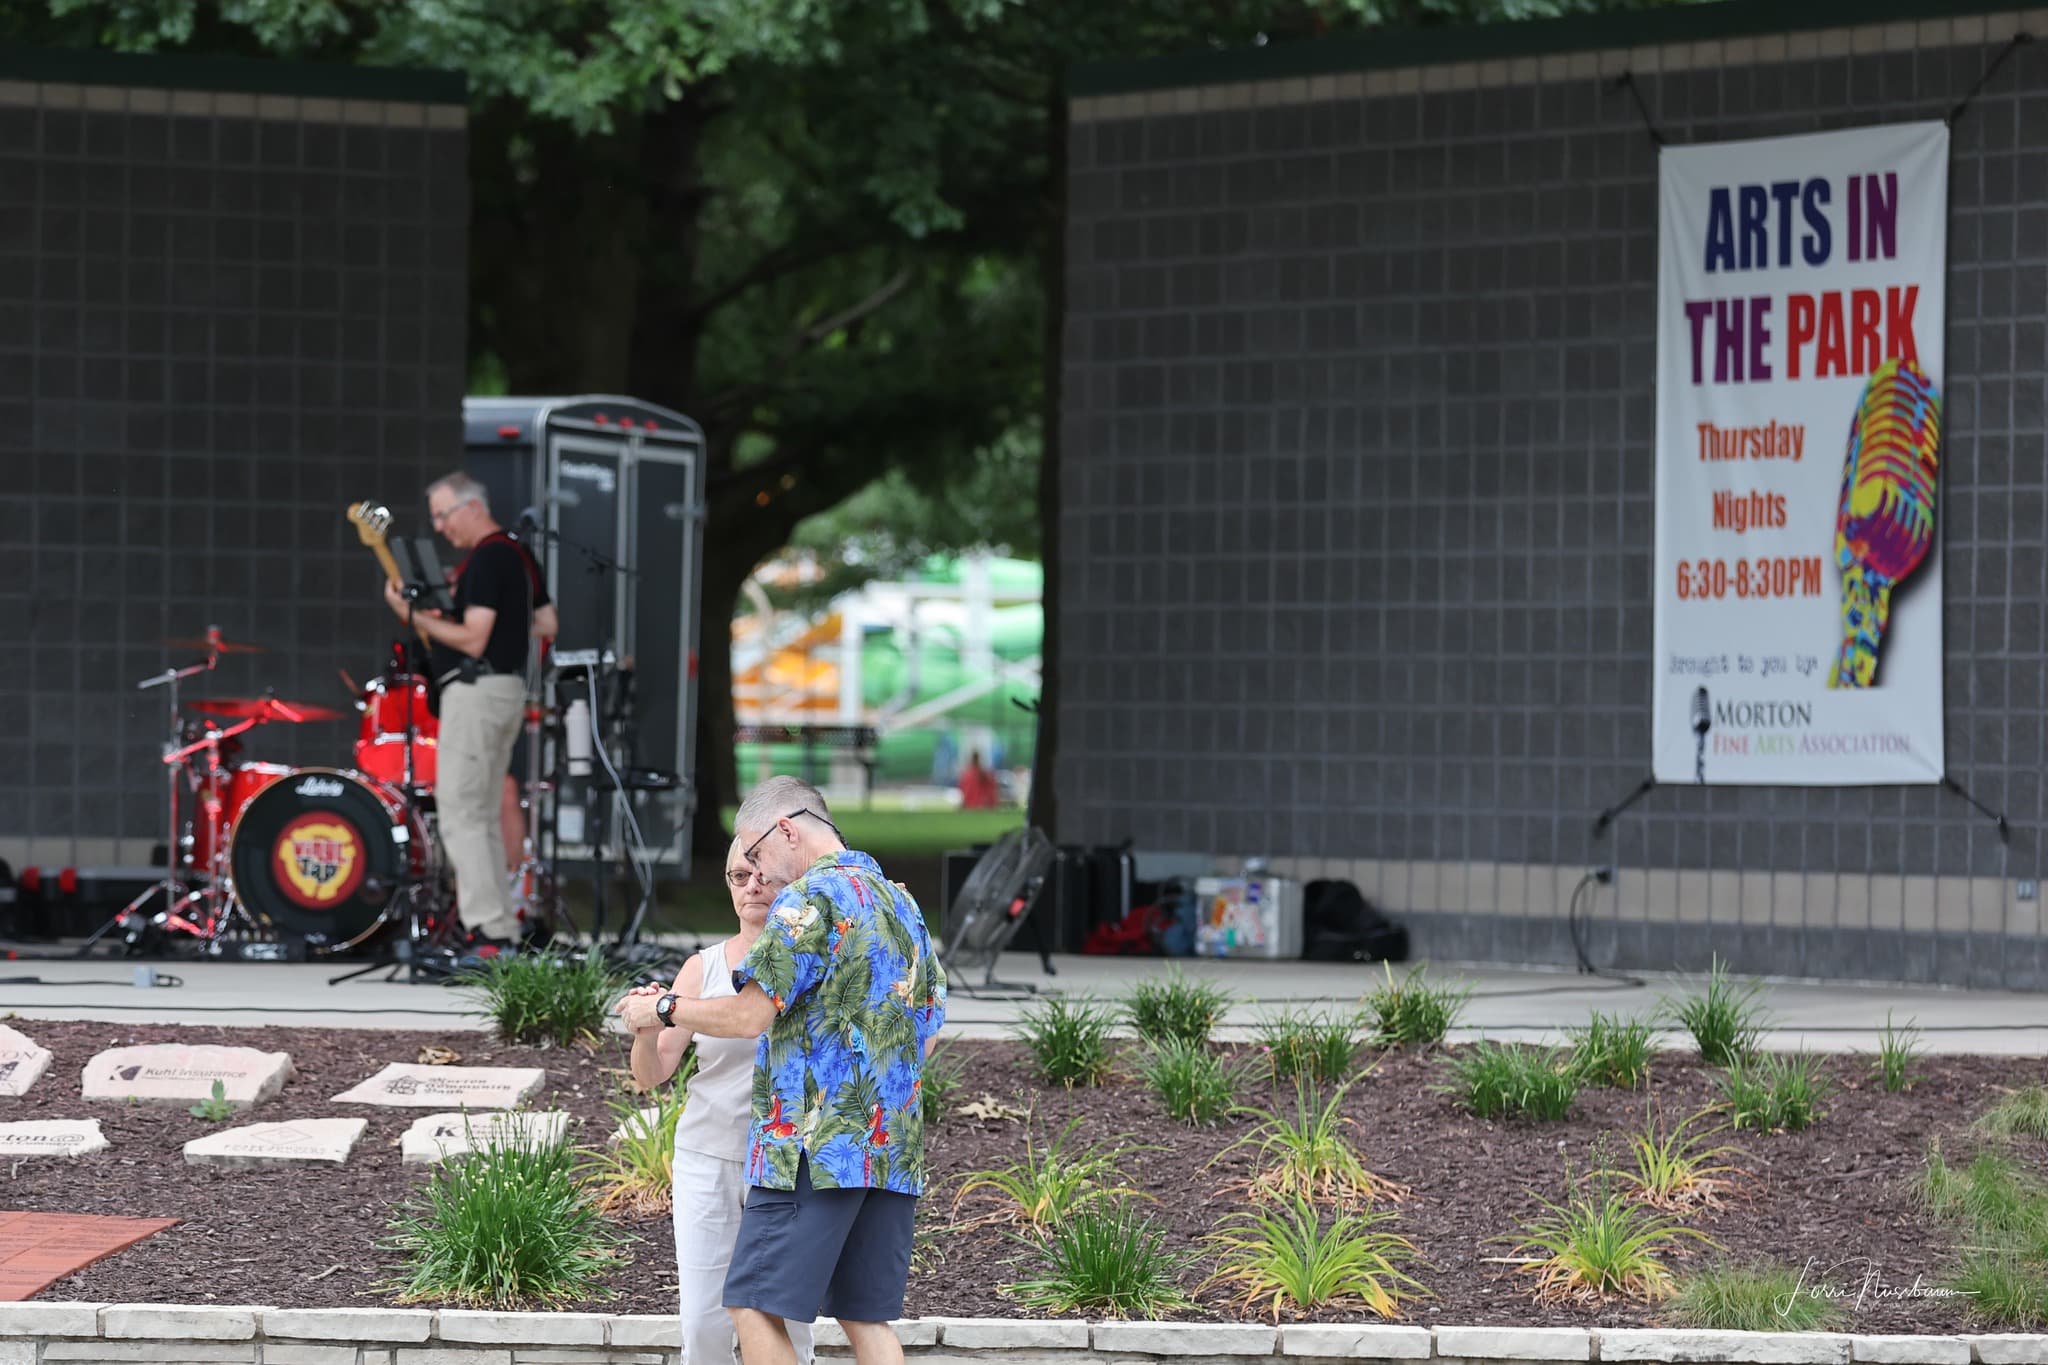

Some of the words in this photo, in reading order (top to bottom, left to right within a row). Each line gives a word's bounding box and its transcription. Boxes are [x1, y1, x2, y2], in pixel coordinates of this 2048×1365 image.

[1704, 177, 1832, 273] ARTS
[1847, 172, 1898, 262] IN
[1685, 296, 1772, 386] THE
[1787, 285, 1919, 380] PARK
[1697, 420, 1804, 461] Thursday
[1712, 488, 1787, 534] Nights
[1676, 557, 1822, 600] 6:30-8:30PM
[1714, 700, 1812, 728] MORTON
[1713, 734, 1749, 754] FINE
[1756, 734, 1796, 754] ARTS
[1800, 734, 1911, 754] ASSOCIATION
[145, 1068, 176, 1077] Kuhl
[179, 1068, 247, 1079] Insurance
